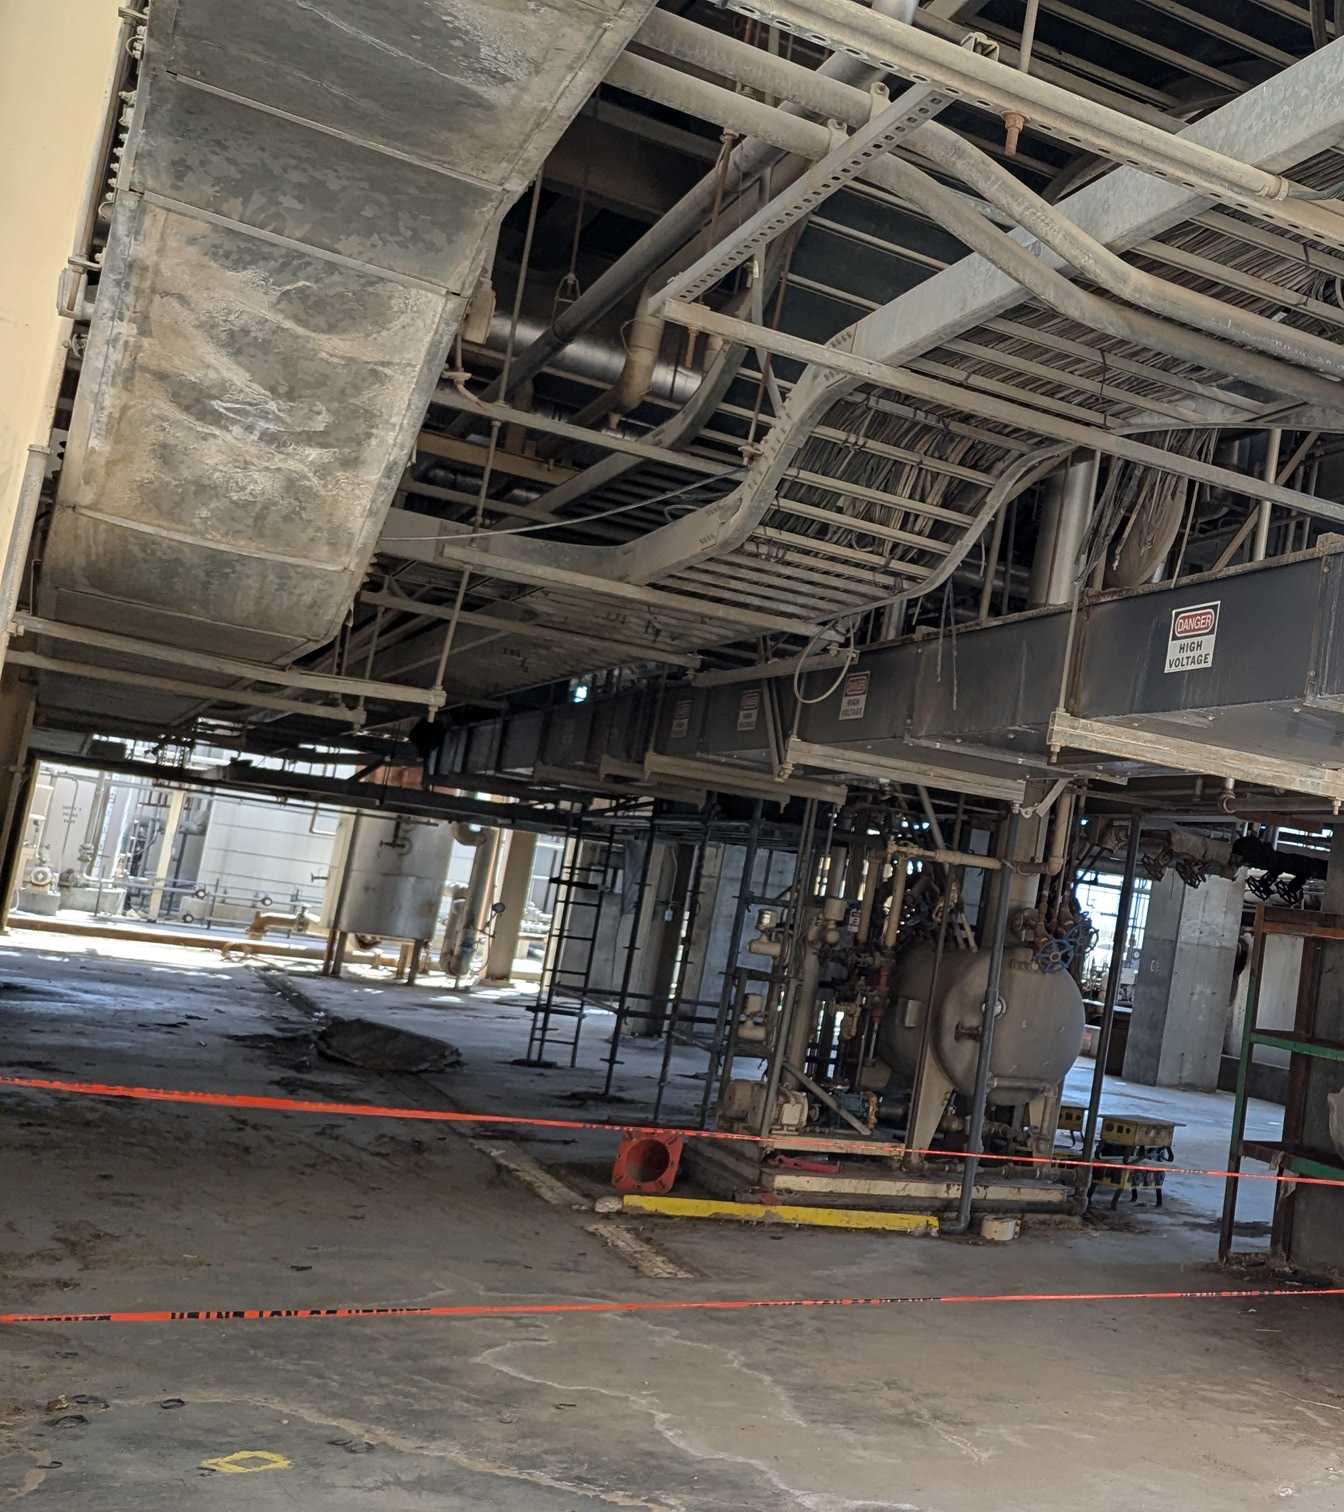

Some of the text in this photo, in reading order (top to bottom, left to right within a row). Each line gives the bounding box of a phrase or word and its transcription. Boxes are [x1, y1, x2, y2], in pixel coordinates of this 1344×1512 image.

[1177, 614, 1212, 632] DANGER
[1179, 640, 1203, 654] HIGH
[1168, 653, 1210, 669] VOLTAGE
